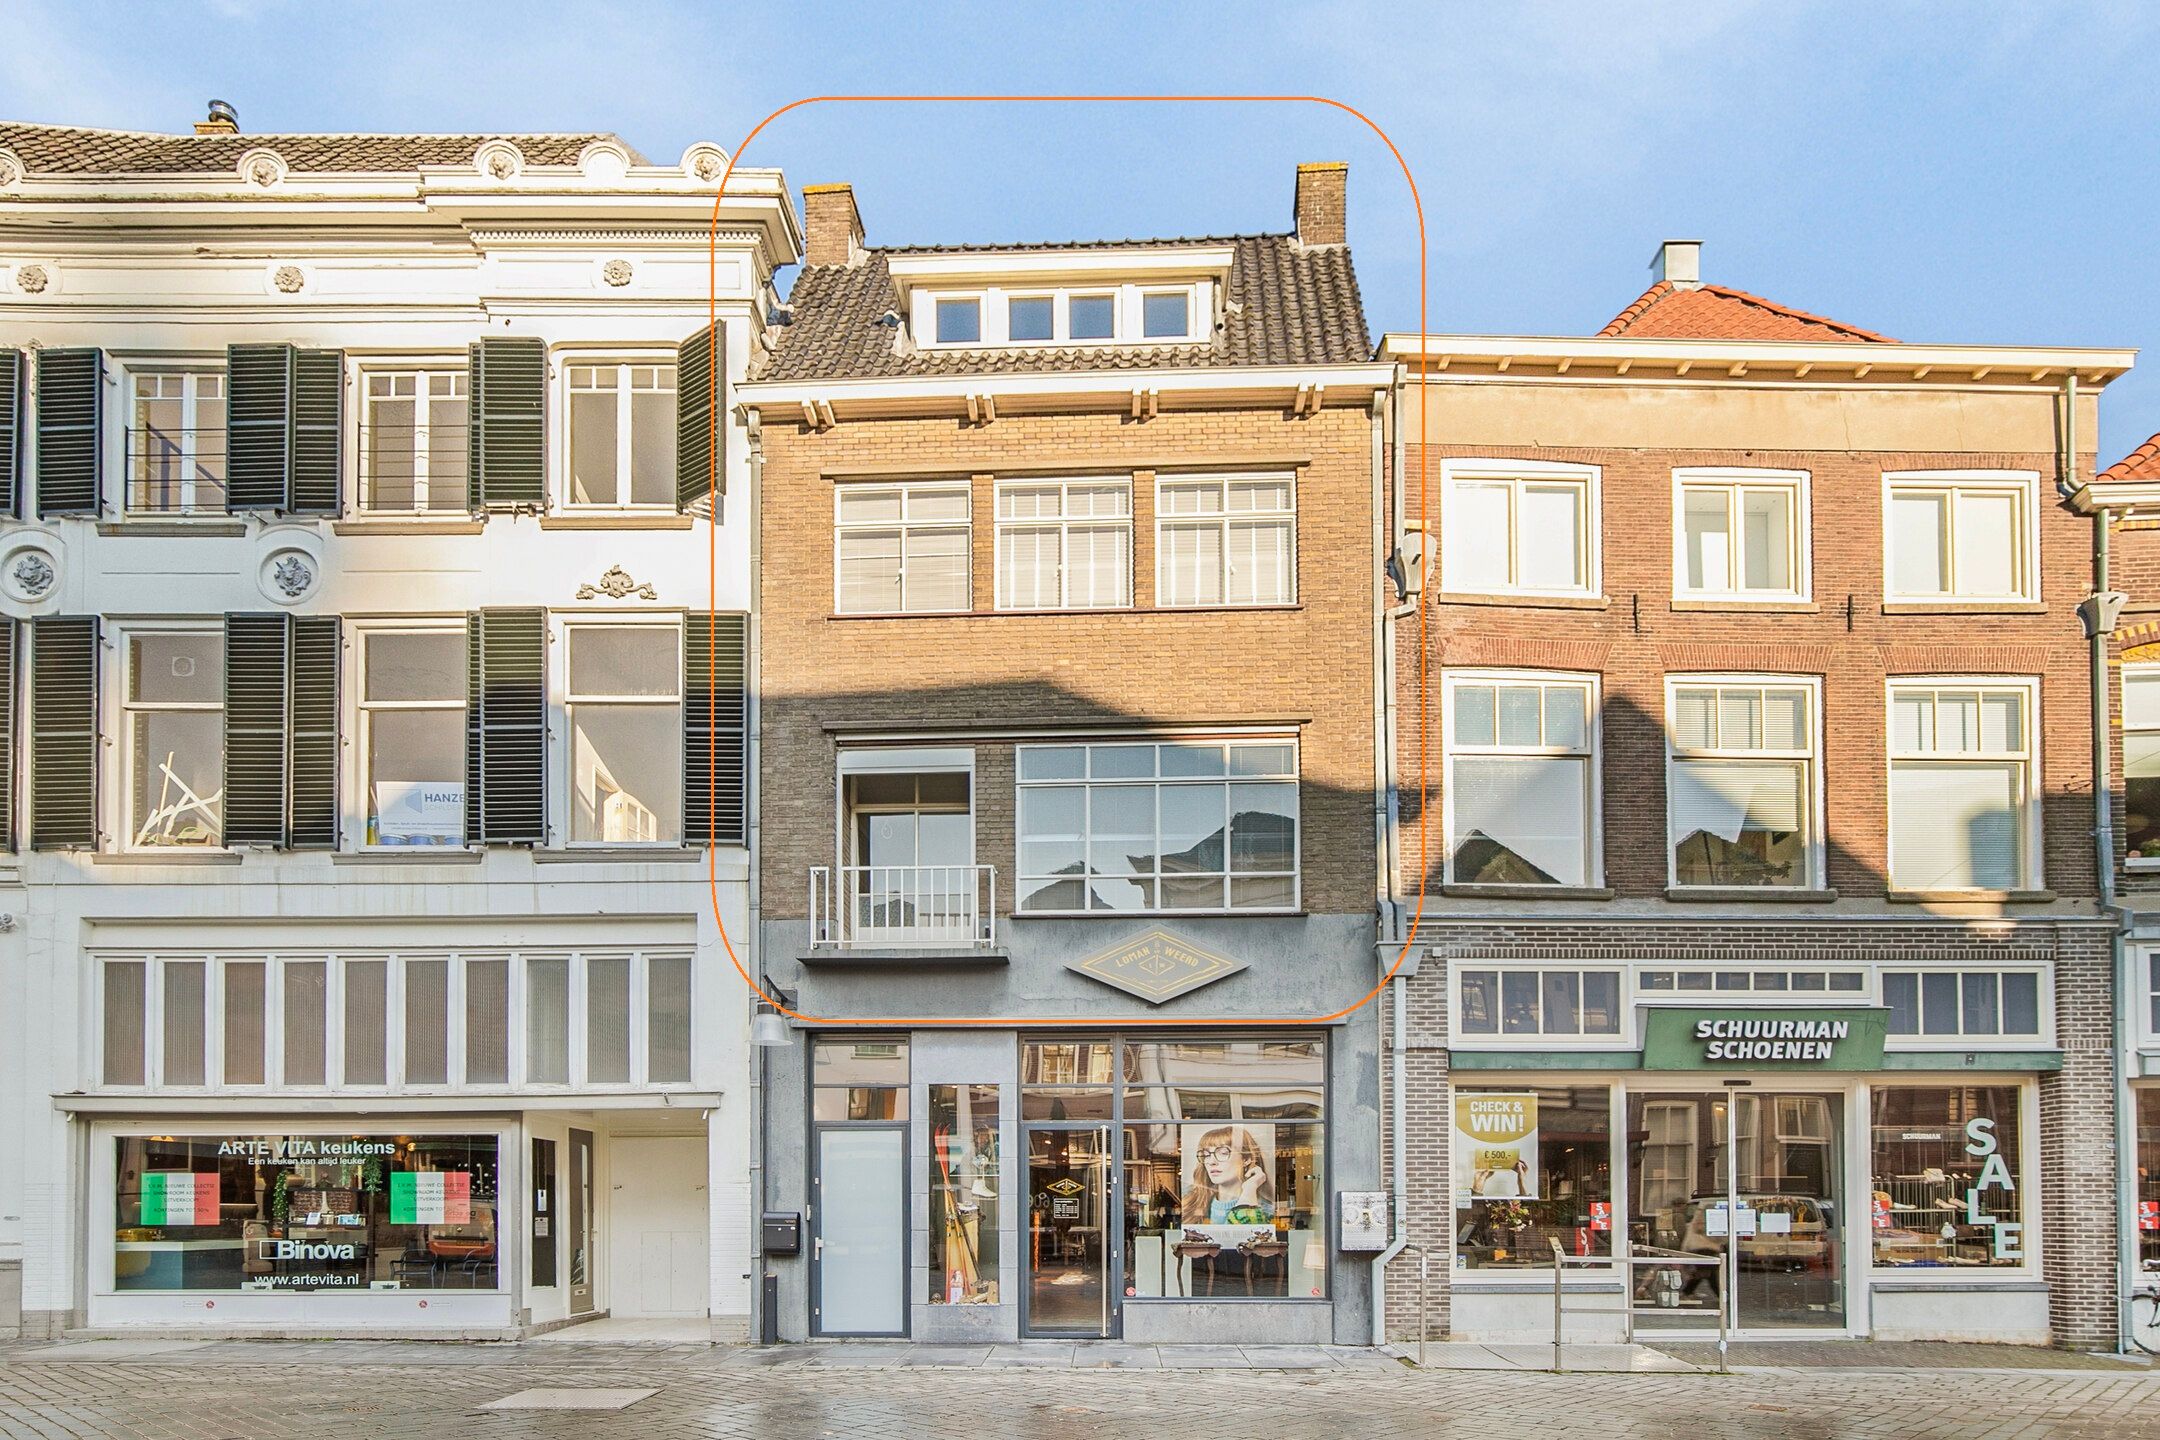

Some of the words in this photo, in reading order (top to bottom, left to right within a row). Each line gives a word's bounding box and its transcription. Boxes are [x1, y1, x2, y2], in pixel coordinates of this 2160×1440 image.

[1115, 946, 1151, 968] LOMAN
[1696, 1020, 1849, 1039] SCHUURMAN
[1706, 1041, 1833, 1060] SCHOENEN
[1470, 1101, 1511, 1112] CHECK
[1513, 1101, 1523, 1112] &
[1470, 1114, 1524, 1132] WIN!
[217, 1141, 269, 1155] ARTE
[274, 1141, 317, 1155] VITA
[321, 1141, 396, 1155] keukens
[1484, 1151, 1489, 1159] €
[248, 1157, 265, 1165] Een
[267, 1157, 299, 1165] keuken
[300, 1157, 316, 1165] kan
[317, 1157, 338, 1167] altijd
[339, 1157, 366, 1165] leuker
[1965, 1117, 2024, 1259] SALE
[1595, 1203, 1608, 1230] SALE
[277, 1240, 355, 1260] Binova
[254, 1273, 360, 1286] www.artevita.nl
